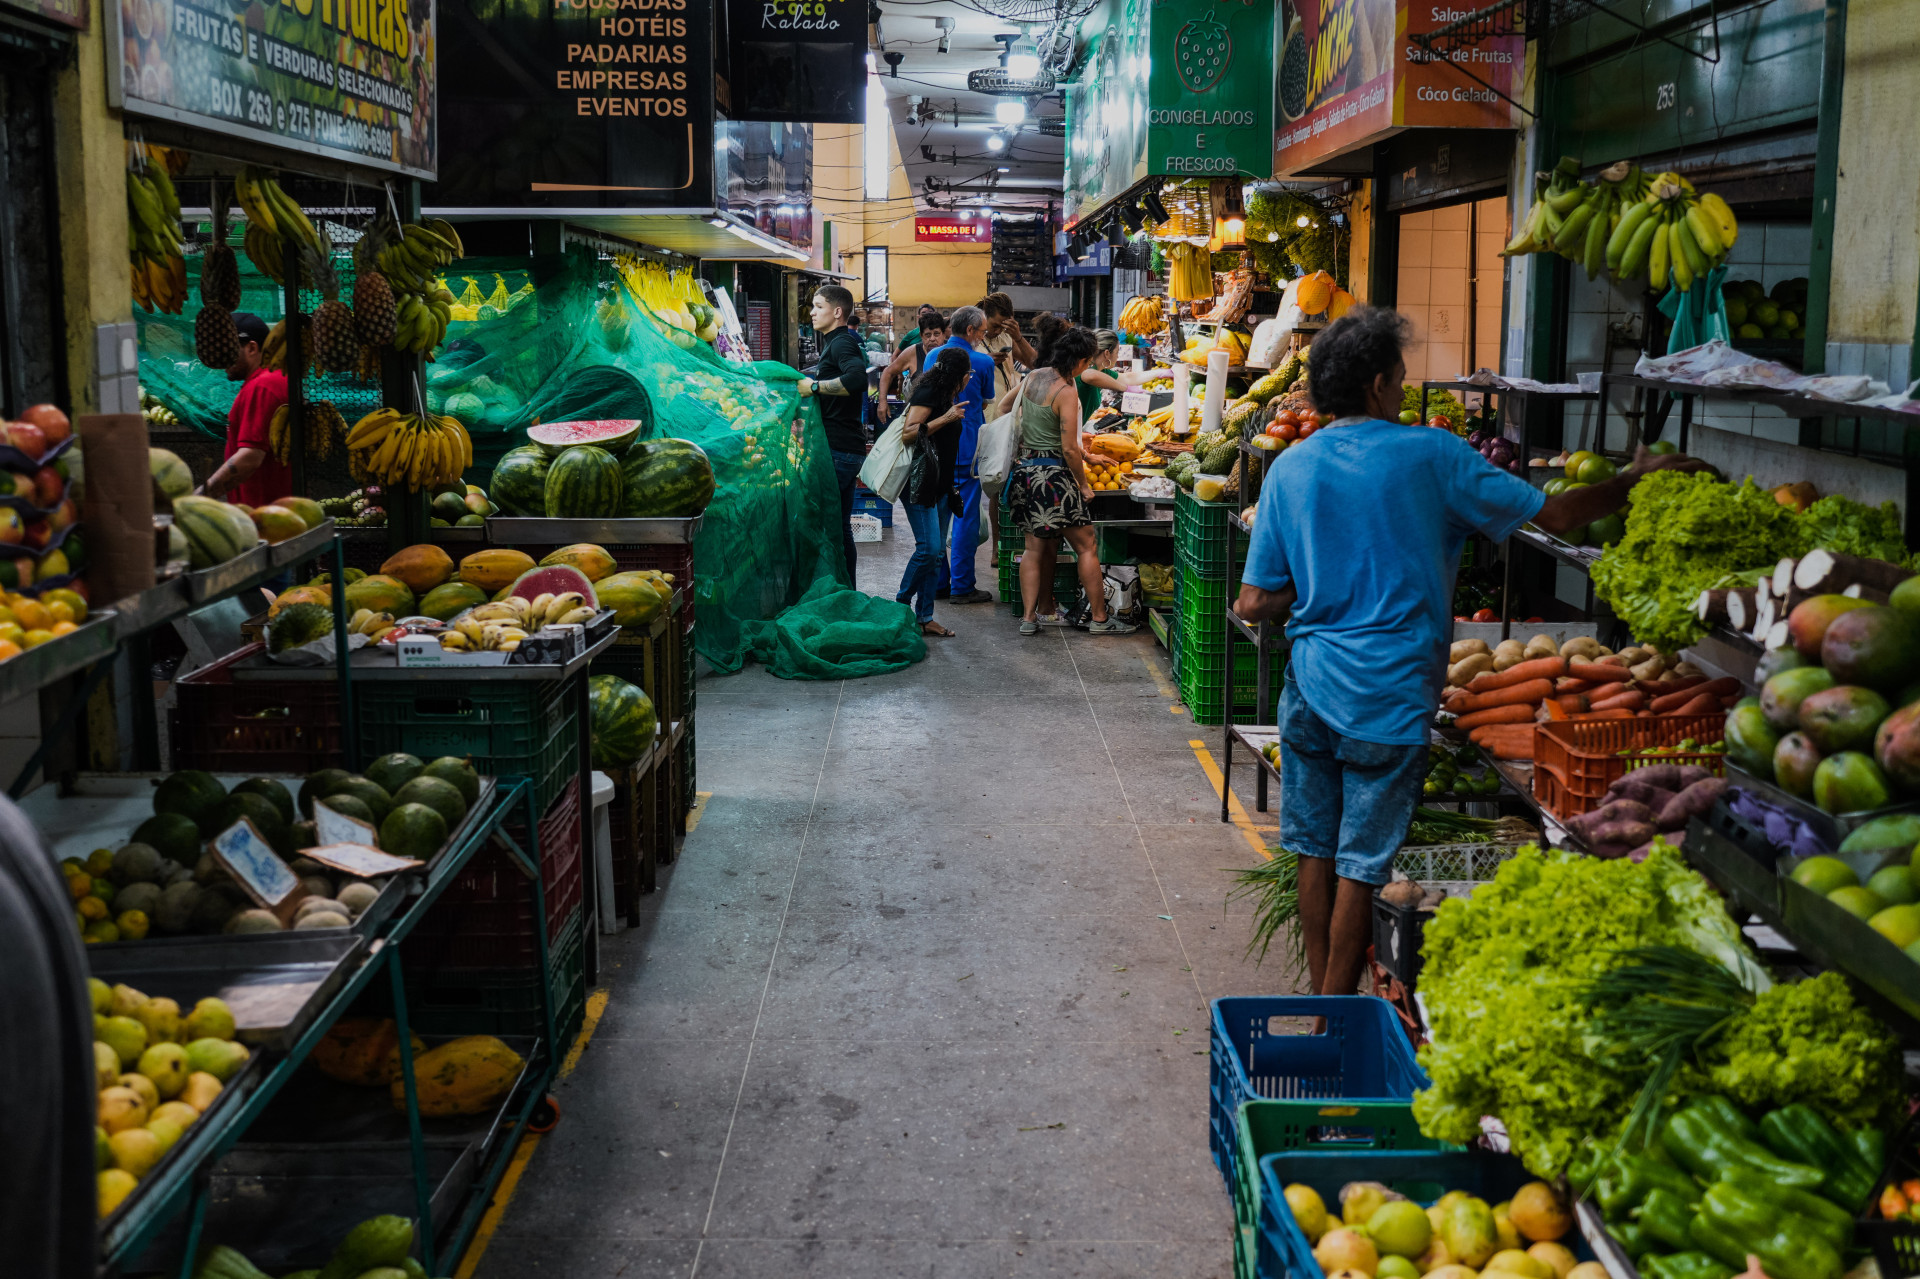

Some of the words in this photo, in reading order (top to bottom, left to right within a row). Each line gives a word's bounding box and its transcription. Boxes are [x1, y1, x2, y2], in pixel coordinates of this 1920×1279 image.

[600, 13, 687, 37] HOTÉIS
[762, 3, 840, 30] Ralado
[175, 4, 242, 54] FRUTAS
[248, 32, 259, 60] E
[263, 39, 335, 86] VERDURAS
[337, 66, 413, 114] SELECIONADAS
[567, 44, 687, 64] PADARIAS
[1452, 47, 1468, 62] de
[1472, 48, 1513, 63] Frutas
[557, 71, 687, 90] EMPRESAS
[1417, 86, 1449, 102] Côco
[1452, 87, 1498, 103] Gelado
[1656, 83, 1675, 110] 253
[211, 78, 243, 118] BOX
[248, 90, 273, 127] 263
[277, 106, 285, 130] e
[289, 102, 311, 137] 275
[577, 97, 687, 117] EVENTOS
[1149, 109, 1254, 125] CONGELADOS
[1196, 133, 1206, 149] E
[1166, 156, 1236, 172] FRESCOS
[929, 225, 958, 234] MASSA
[959, 226, 970, 234] DE
